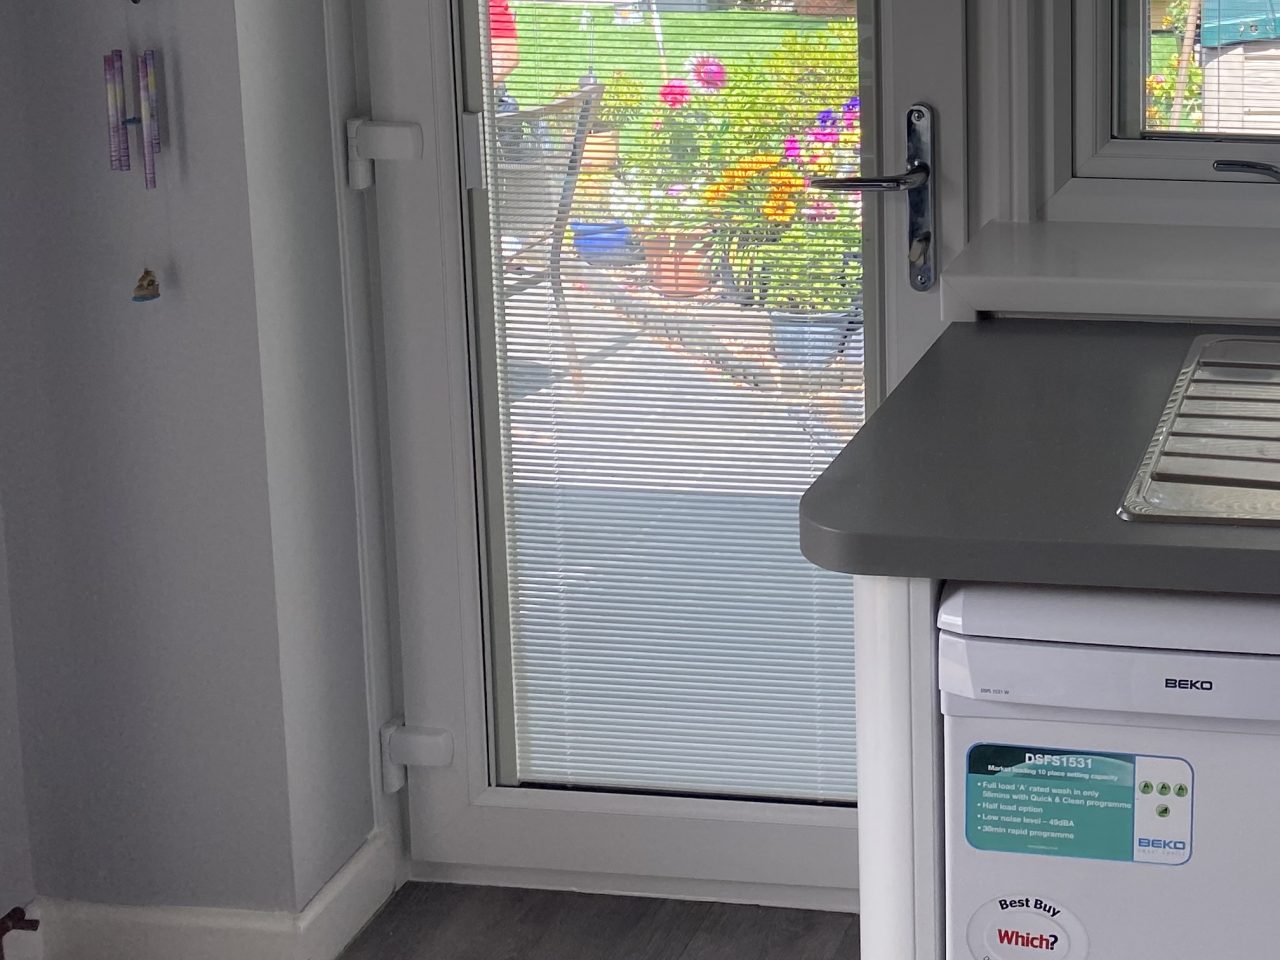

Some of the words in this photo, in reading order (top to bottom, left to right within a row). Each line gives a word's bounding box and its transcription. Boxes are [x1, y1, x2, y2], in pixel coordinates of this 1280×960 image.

[1165, 678, 1213, 691] BEKO
[1025, 752, 1093, 769] DSFS1531
[988, 764, 1012, 773] Market
[1066, 771, 1089, 779] setting
[982, 781, 997, 789] Full
[998, 783, 1016, 791] load
[1029, 785, 1050, 793] rated
[1082, 790, 1100, 798] only
[982, 802, 998, 810] Half
[999, 803, 1017, 811] load
[1018, 805, 1044, 813] option
[1012, 793, 1029, 801] with
[1030, 794, 1053, 803] Quick
[1062, 797, 1085, 805] Clean
[1086, 800, 1132, 809] programme
[982, 813, 999, 821] Low
[1000, 815, 1022, 823] noise
[1023, 816, 1041, 824] level
[1007, 828, 1028, 836] rapid
[1029, 830, 1075, 839] programme
[1138, 837, 1186, 851] BEKO
[998, 898, 1031, 911] Best
[1034, 898, 1061, 918] Buy
[997, 928, 1059, 951] Which?
